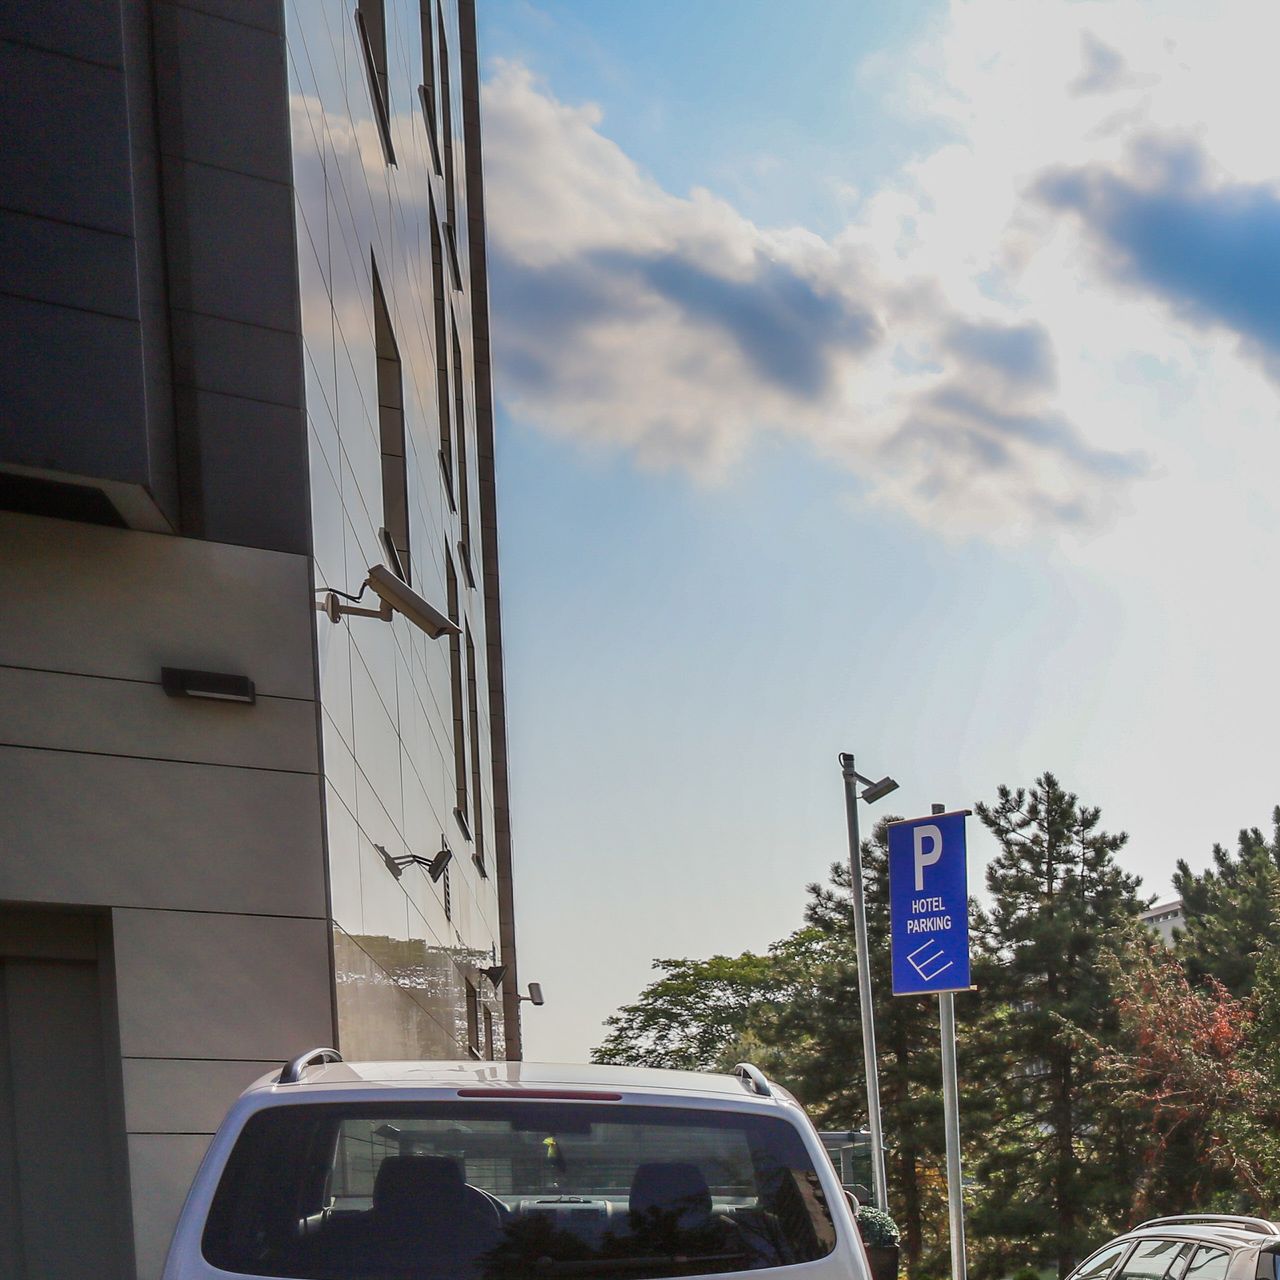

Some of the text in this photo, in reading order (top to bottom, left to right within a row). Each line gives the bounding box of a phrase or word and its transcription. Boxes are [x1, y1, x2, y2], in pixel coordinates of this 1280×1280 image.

[913, 824, 943, 891] P
[911, 897, 945, 914] HOTEL
[906, 916, 952, 934] PARKING
